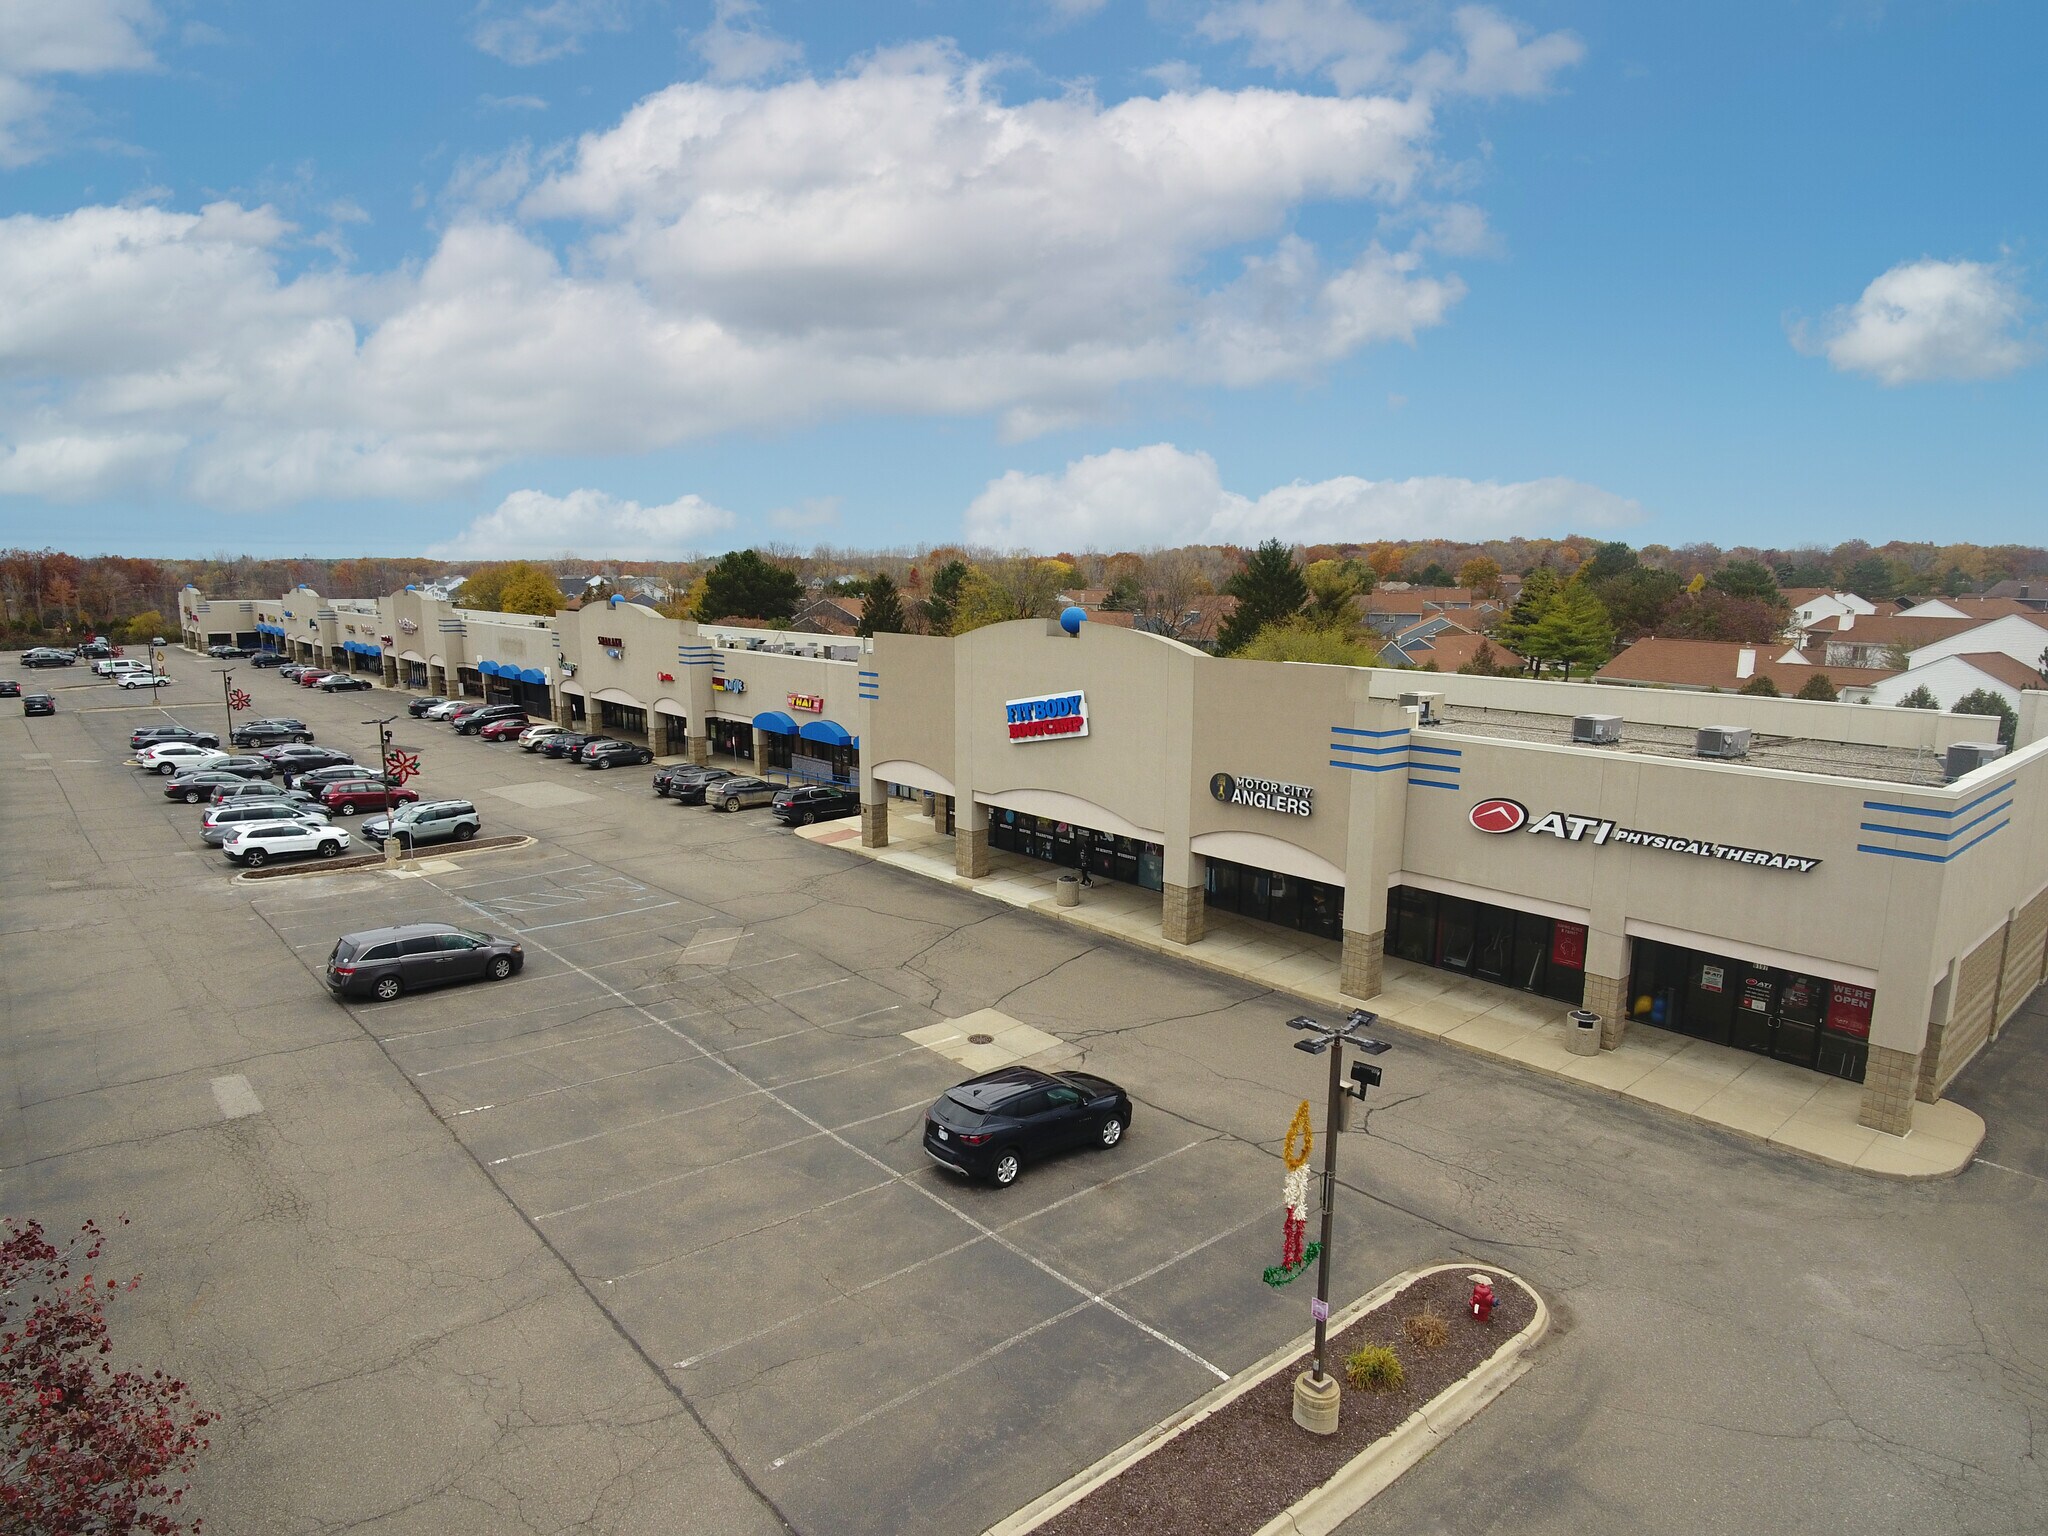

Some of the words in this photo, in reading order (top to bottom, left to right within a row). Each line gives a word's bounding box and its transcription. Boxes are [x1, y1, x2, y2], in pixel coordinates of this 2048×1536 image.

[791, 697, 812, 708] THAI
[1006, 702, 1034, 723] FIT
[1033, 695, 1082, 720] BODY
[1236, 777, 1278, 793] MOTOR
[1283, 785, 1311, 798] CITY
[1231, 789, 1310, 817] ANGLERS
[1527, 811, 1616, 845] ATI
[1614, 829, 1714, 856] PHYSICAL
[1714, 846, 1819, 873] THERAPY
[1756, 981, 1773, 990] ATI
[1833, 984, 1872, 1000] WE'RE
[1834, 994, 1869, 1009] OPEN
